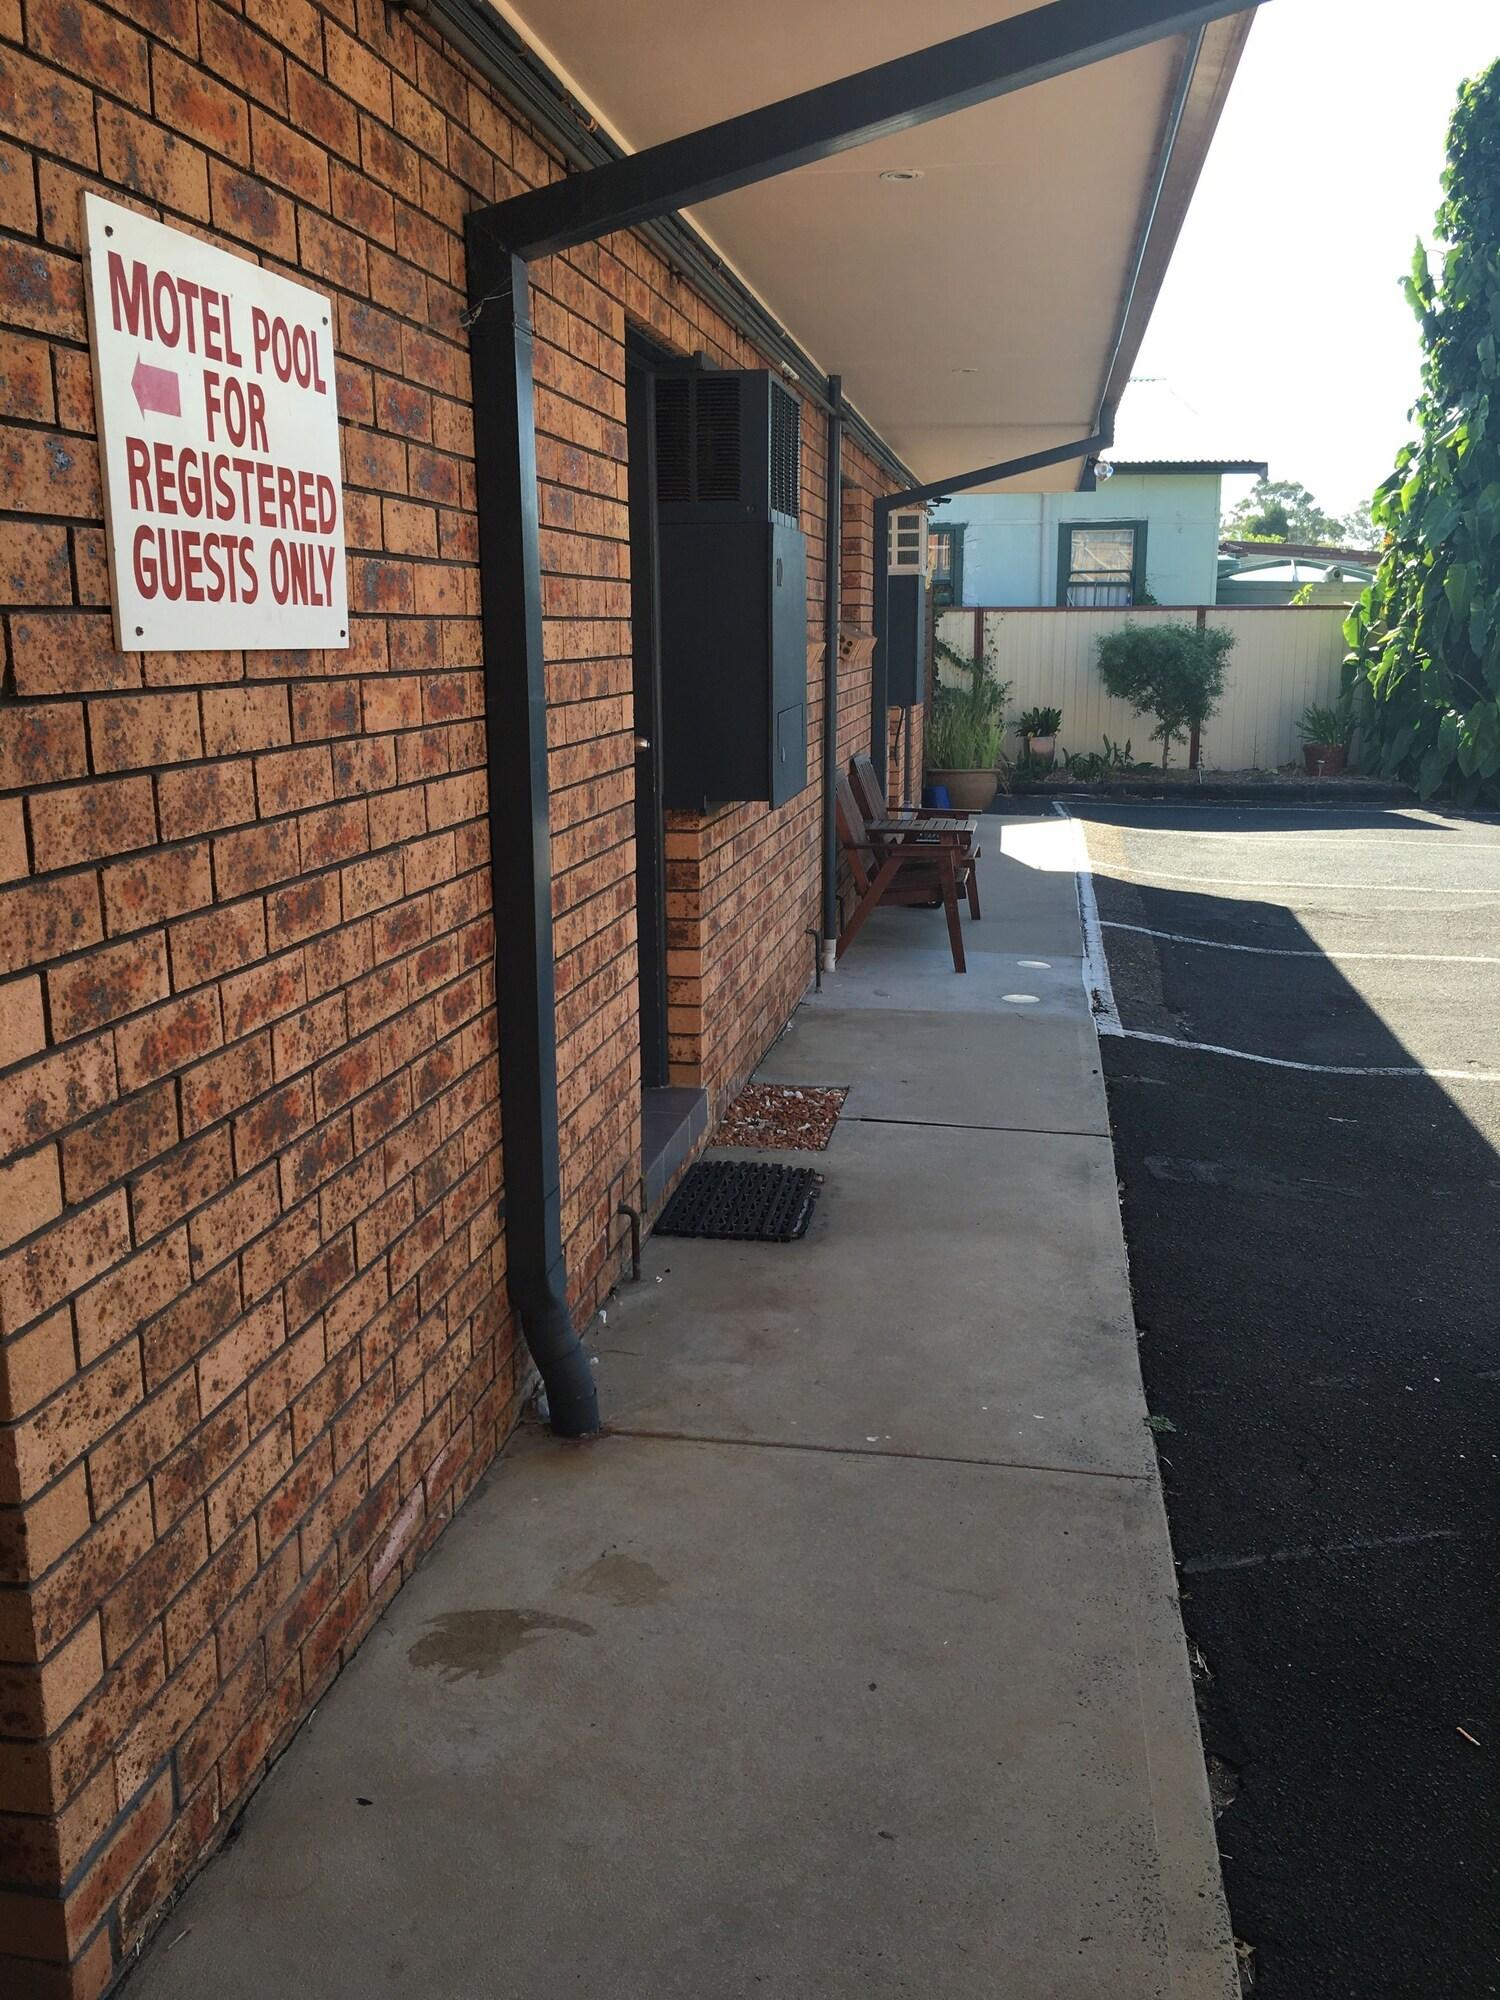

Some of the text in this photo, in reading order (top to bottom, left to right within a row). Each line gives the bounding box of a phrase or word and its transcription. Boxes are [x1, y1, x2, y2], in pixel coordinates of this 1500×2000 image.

[107, 251, 327, 395] MOTEL POOL
[203, 369, 270, 453] FOR
[125, 437, 337, 534] REGISTERED
[133, 525, 336, 607] GUESTS ONLY
